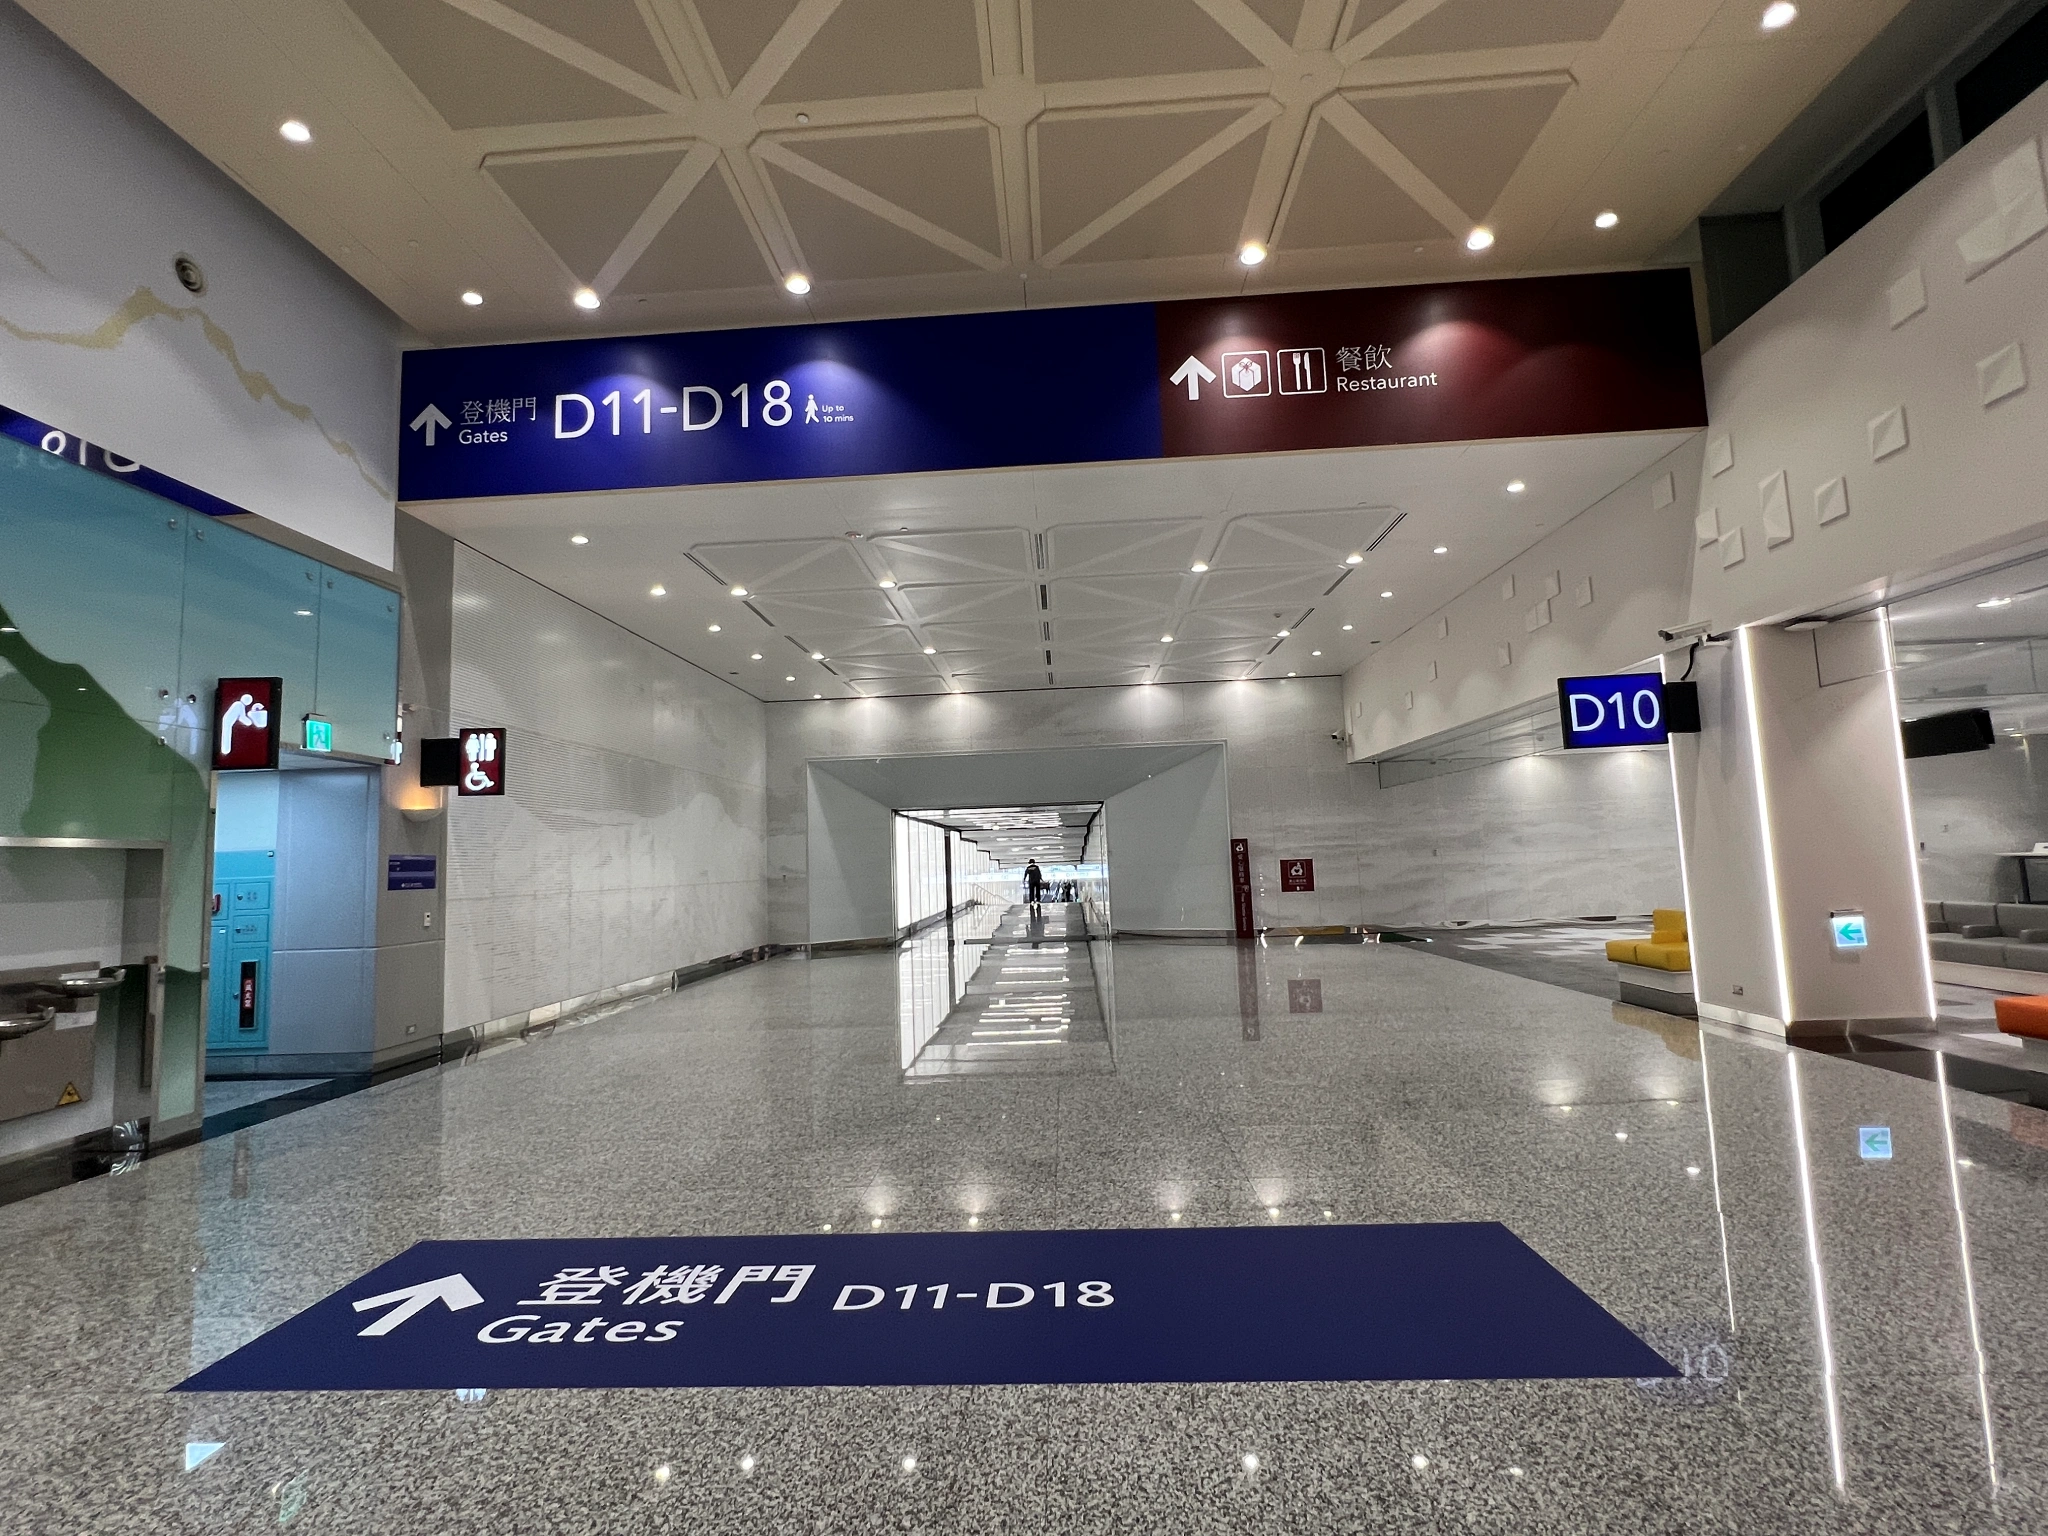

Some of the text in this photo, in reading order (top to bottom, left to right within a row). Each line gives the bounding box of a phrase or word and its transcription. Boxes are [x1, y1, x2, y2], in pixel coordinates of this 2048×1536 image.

[1335, 344, 1393, 372] 餐飲
[1337, 371, 1438, 393] Restaurant
[460, 396, 537, 425] 登機門
[555, 380, 793, 439] D11-D18
[822, 405, 834, 413] Up
[823, 414, 854, 423] 10 mins
[458, 430, 508, 445] Gates
[1569, 689, 1660, 732] D10
[516, 1265, 1115, 1311] 登機門 D11-D18
[477, 1314, 685, 1343] Gates
